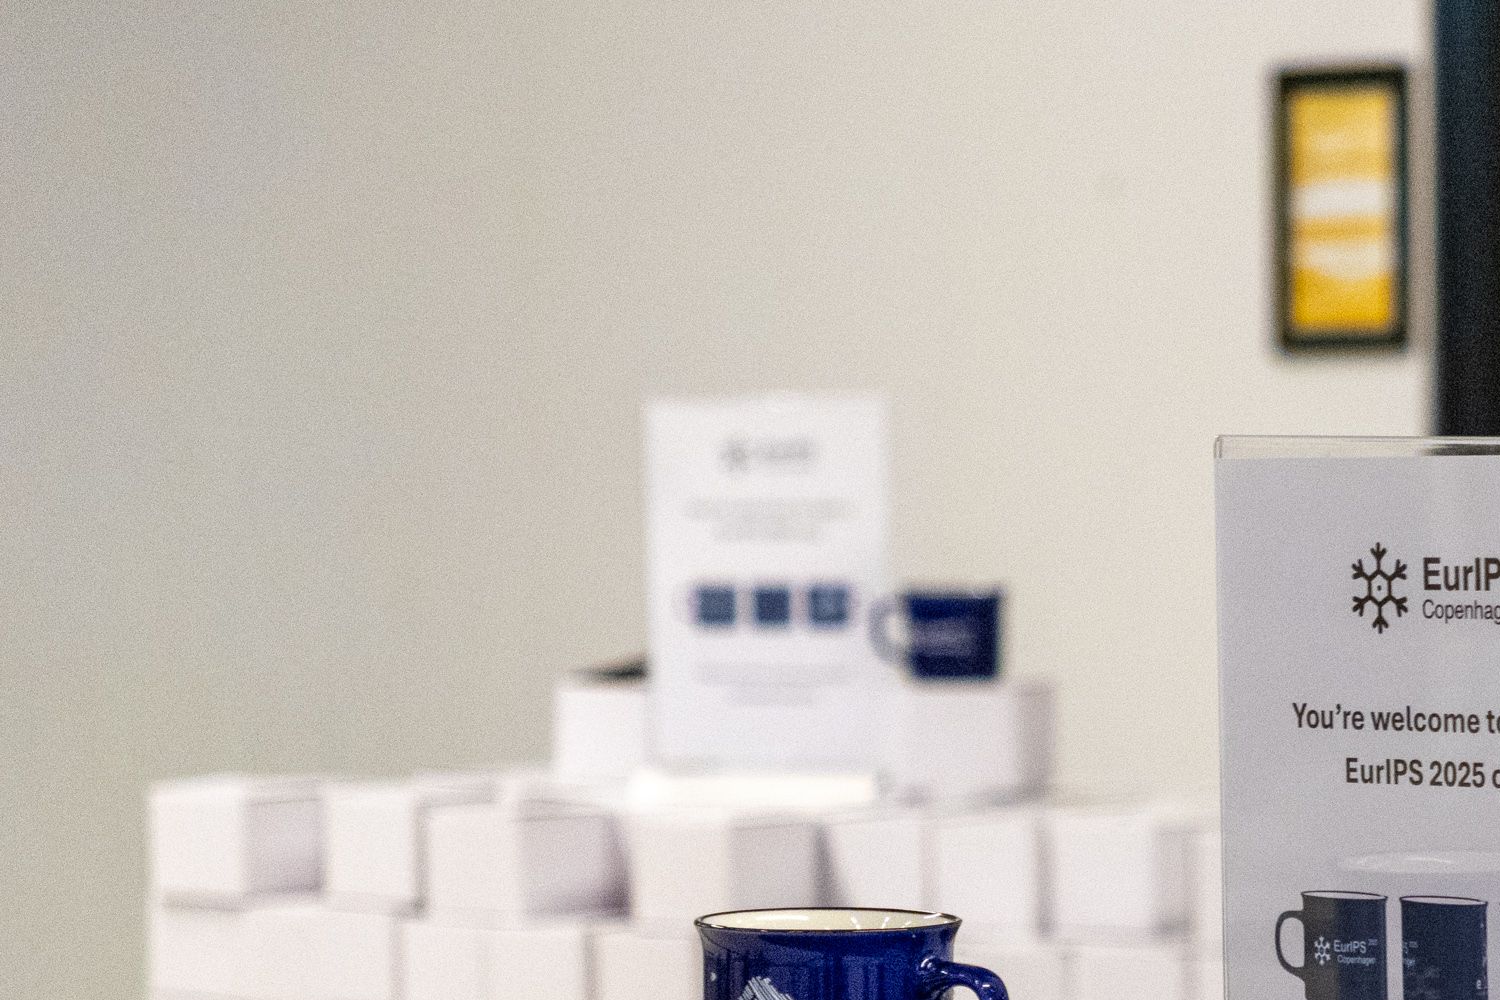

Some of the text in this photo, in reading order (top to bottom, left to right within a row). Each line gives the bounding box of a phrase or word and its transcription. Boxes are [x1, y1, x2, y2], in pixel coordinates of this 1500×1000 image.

[1292, 702, 1365, 731] You’re
[1370, 705, 1481, 734] welcome
[1345, 757, 1424, 786] EurIPS
[1429, 760, 1486, 789] 2025
